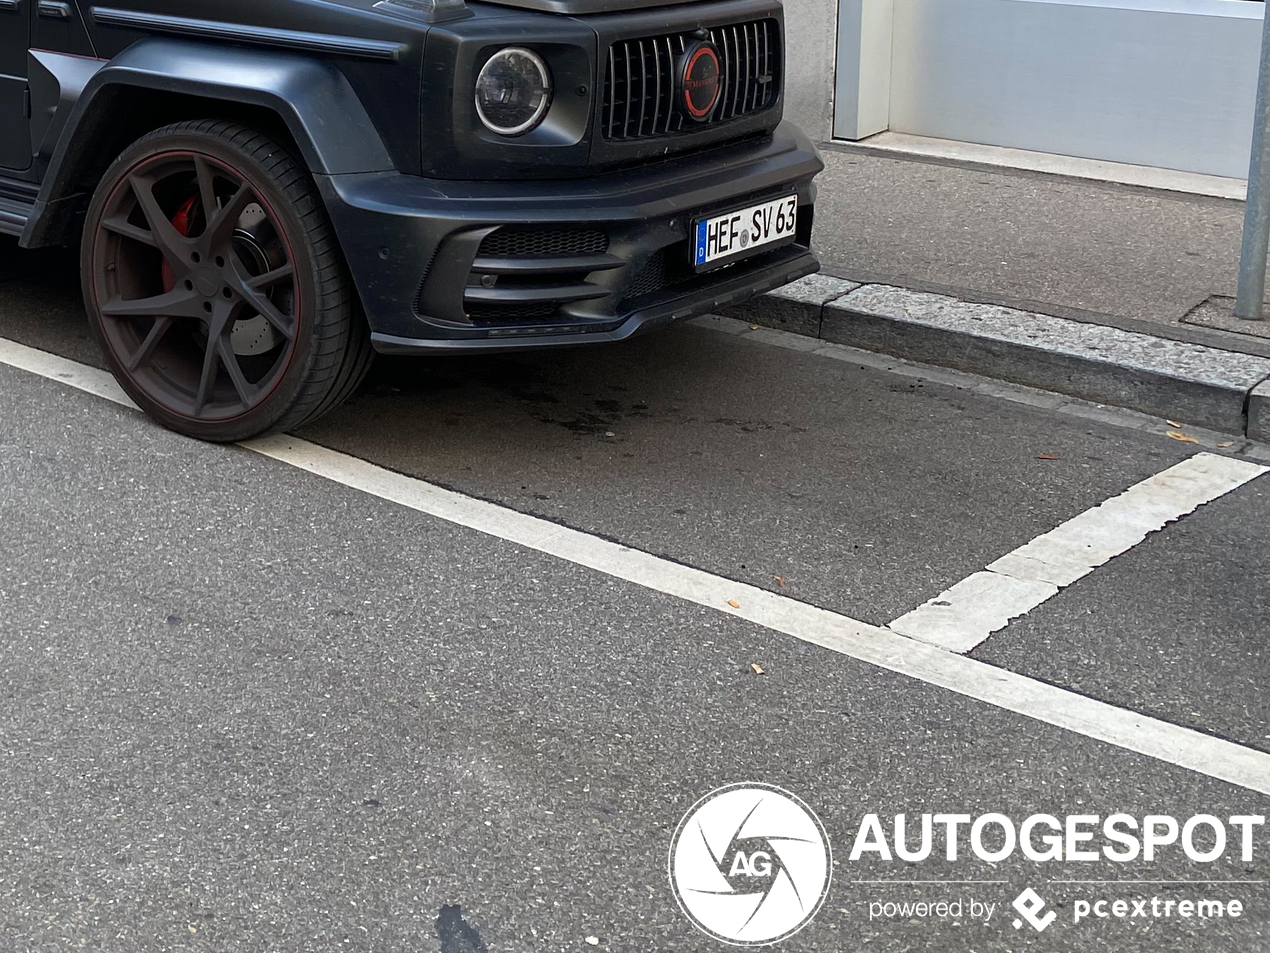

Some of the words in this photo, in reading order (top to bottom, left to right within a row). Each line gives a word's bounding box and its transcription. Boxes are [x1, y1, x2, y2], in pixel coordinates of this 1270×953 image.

[707, 215, 741, 257] HEF
[751, 205, 773, 242] SV
[775, 199, 796, 234] 63
